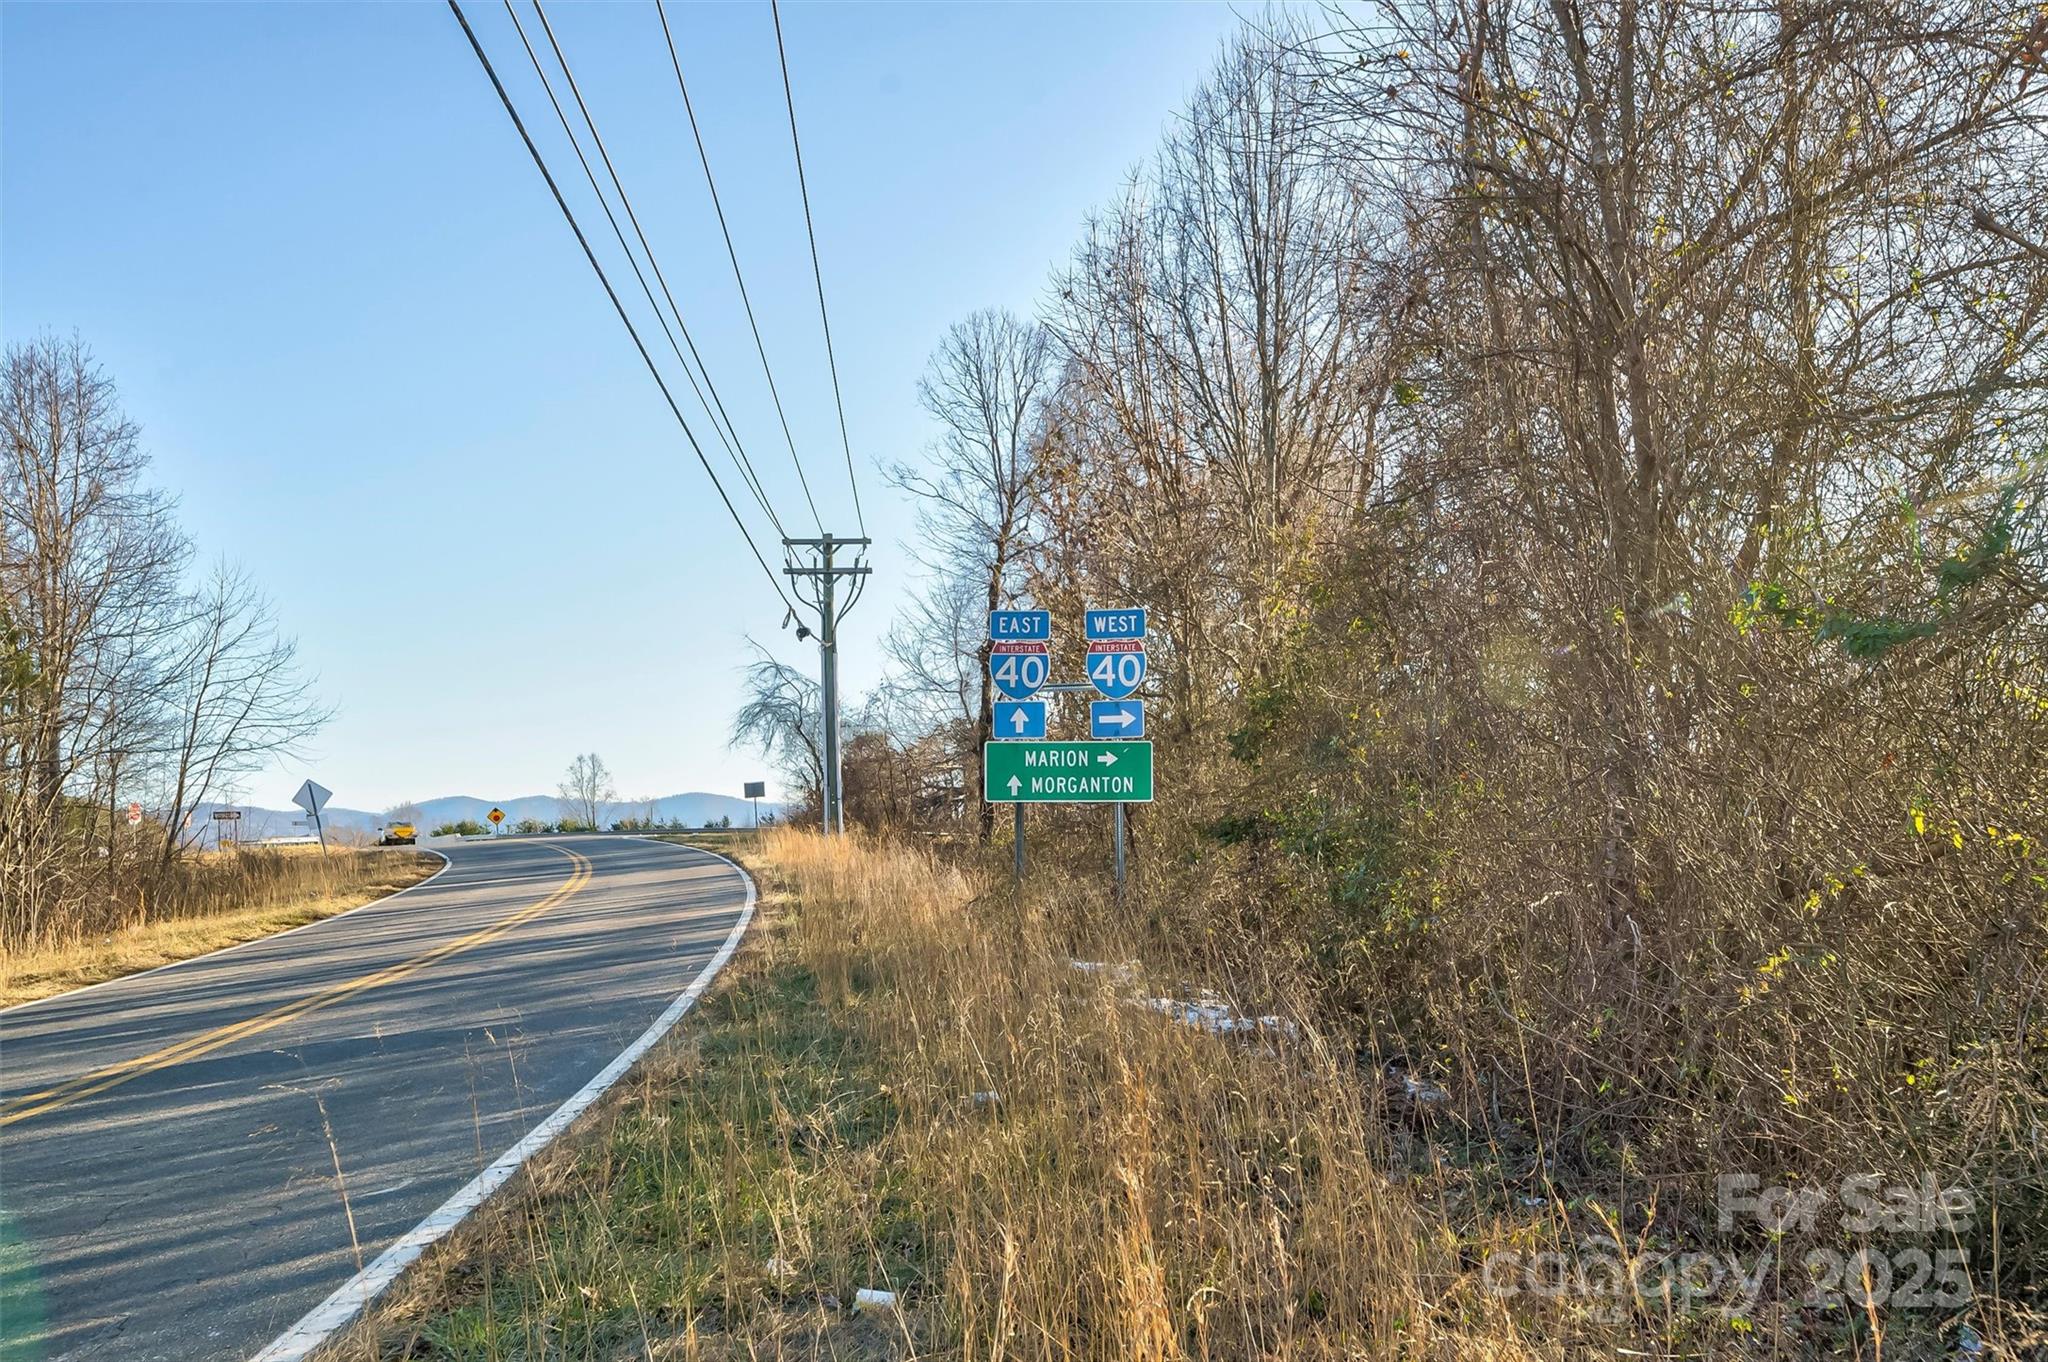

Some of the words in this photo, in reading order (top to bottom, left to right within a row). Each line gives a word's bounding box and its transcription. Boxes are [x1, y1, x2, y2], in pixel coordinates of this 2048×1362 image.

[999, 617, 1041, 633] EAST
[1094, 615, 1138, 633] WEST
[999, 644, 1040, 653] INTERSTATE
[1095, 643, 1136, 652] INTERSTATE
[995, 656, 1045, 689] 40
[1092, 654, 1141, 688] 40
[1025, 750, 1089, 767] MARION
[1031, 776, 1134, 794] MORGANTON
